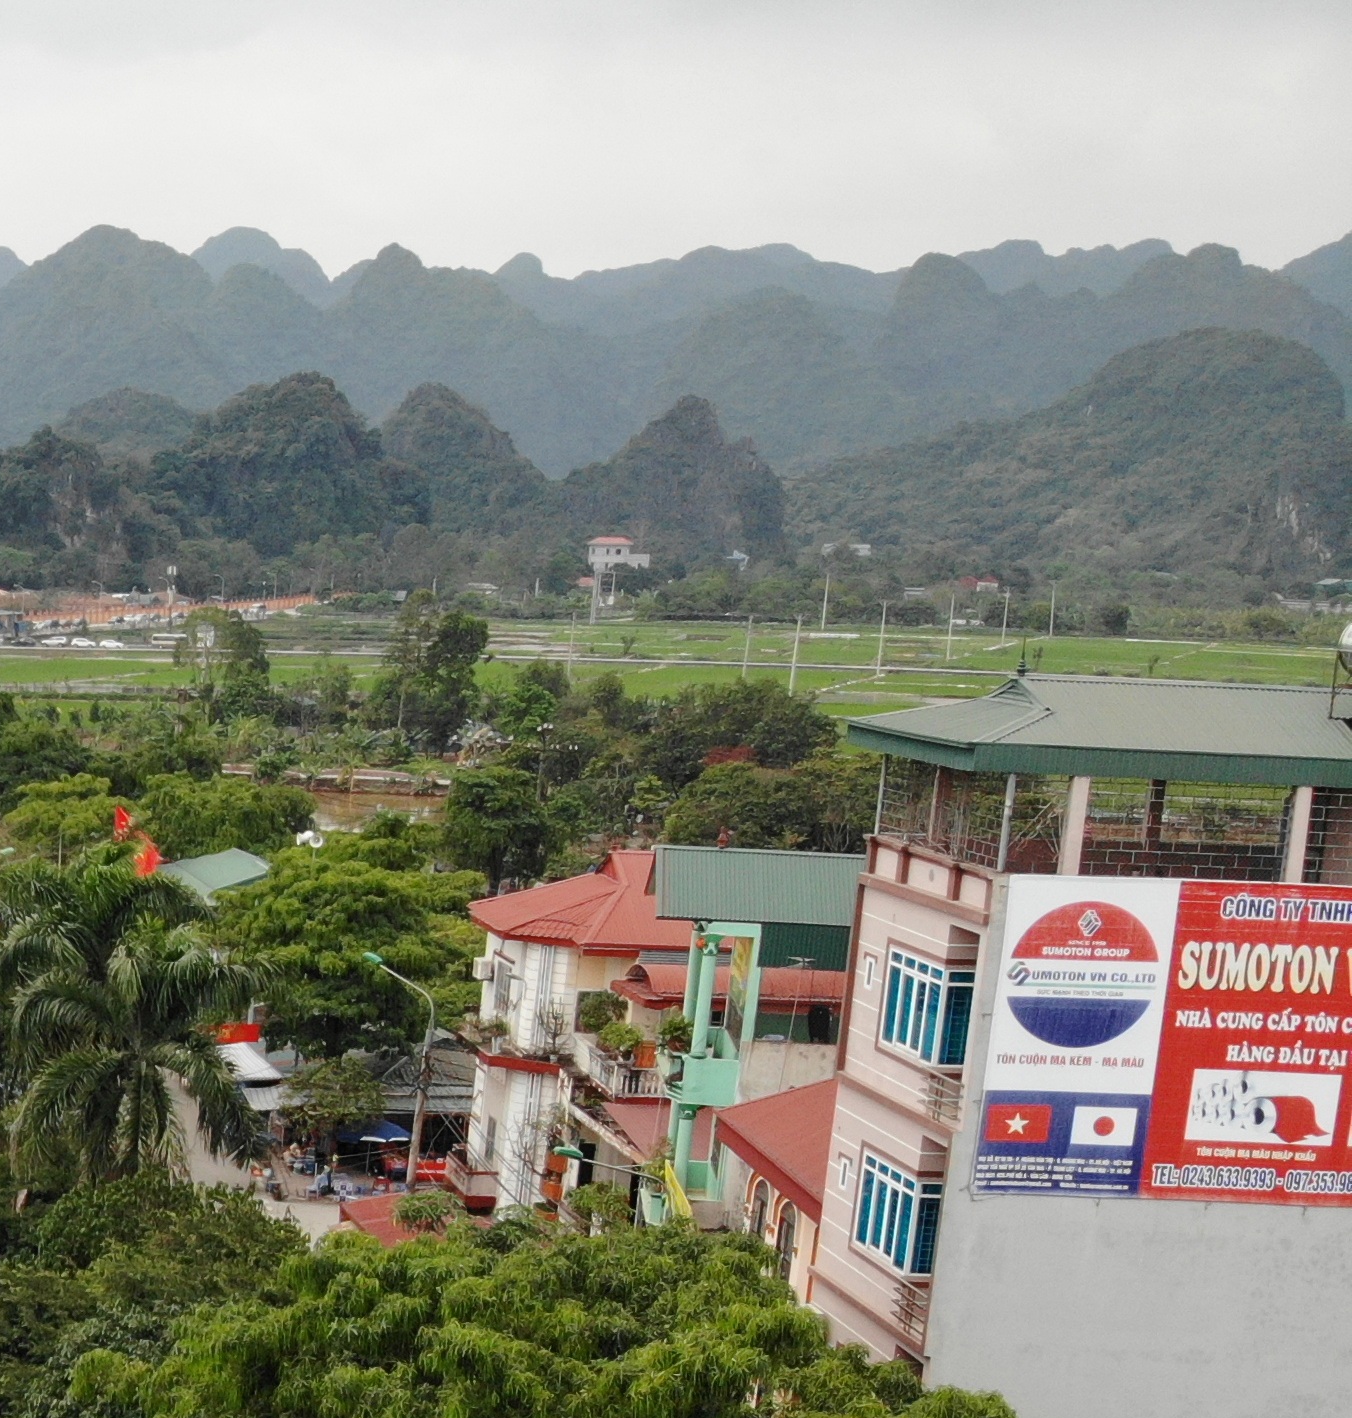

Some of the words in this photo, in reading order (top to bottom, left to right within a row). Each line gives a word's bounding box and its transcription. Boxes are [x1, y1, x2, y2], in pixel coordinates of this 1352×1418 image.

[1221, 893, 1276, 920] CÔNG
[1280, 898, 1306, 921] TY
[1041, 945, 1092, 957] SUMOTON
[1093, 946, 1131, 958] GROUP
[1090, 971, 1107, 983] VN
[1177, 940, 1339, 995] SUMOTON
[1175, 1007, 1212, 1029] NHÀ
[1216, 1011, 1263, 1030] CUNG
[1267, 1007, 1302, 1032] CẤP
[1304, 1012, 1340, 1034] TÔN
[1225, 1040, 1275, 1063] HÀNG
[1277, 1040, 1316, 1065] ĐẦU
[1318, 1049, 1348, 1071] TẠI
[1152, 1164, 1178, 1187] TEL:
[1181, 1165, 1277, 1191] 0243.633.9393
